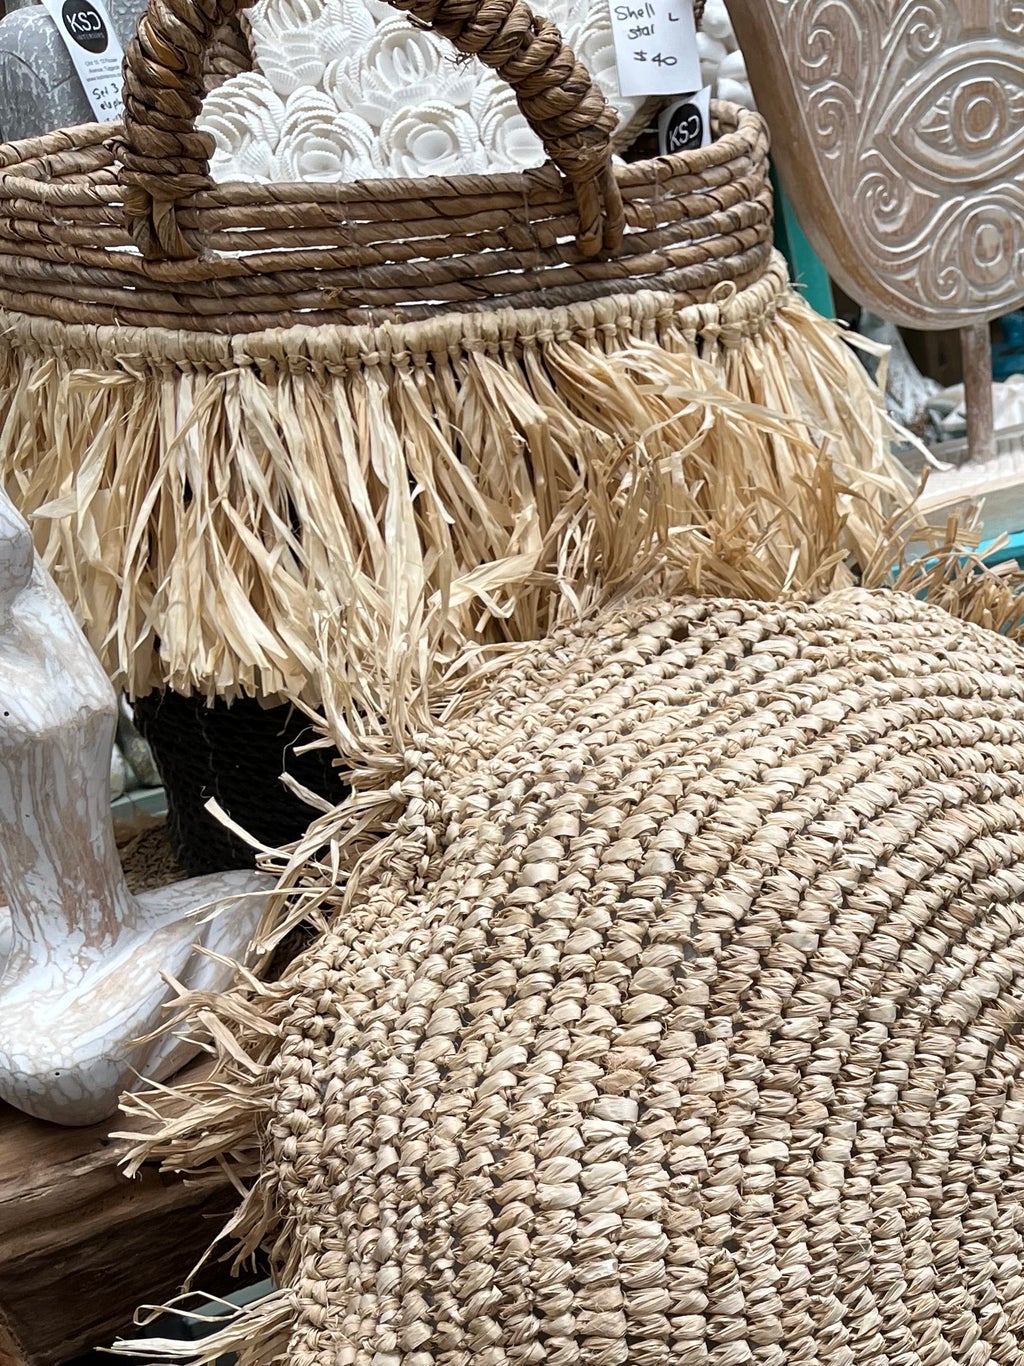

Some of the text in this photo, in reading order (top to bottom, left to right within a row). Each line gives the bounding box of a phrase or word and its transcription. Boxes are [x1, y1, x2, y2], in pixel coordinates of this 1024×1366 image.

[66, 11, 102, 32] KSD
[614, 3, 679, 22] Shell L
[628, 24, 655, 40] star
[111, 82, 119, 94] 3
[669, 115, 700, 151] KSD
